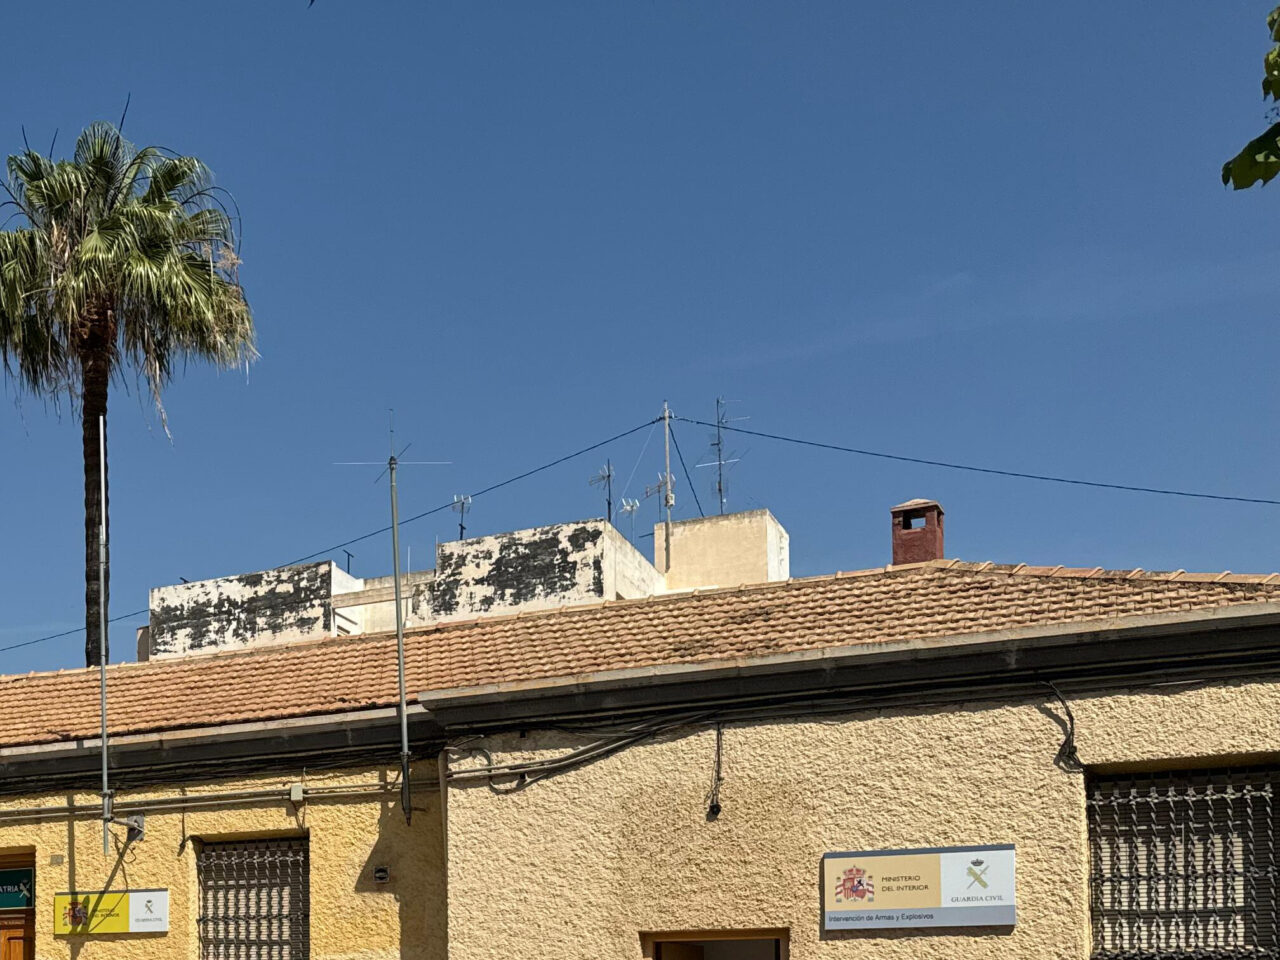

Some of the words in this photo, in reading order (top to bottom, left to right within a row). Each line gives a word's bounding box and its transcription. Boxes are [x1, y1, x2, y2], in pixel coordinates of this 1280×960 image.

[881, 875, 921, 883] MINISTERIO
[896, 884, 929, 892] INTERIOR
[950, 895, 984, 903] GUARDIA
[828, 914, 865, 922] Intervención
[900, 912, 934, 921] Explosivos
